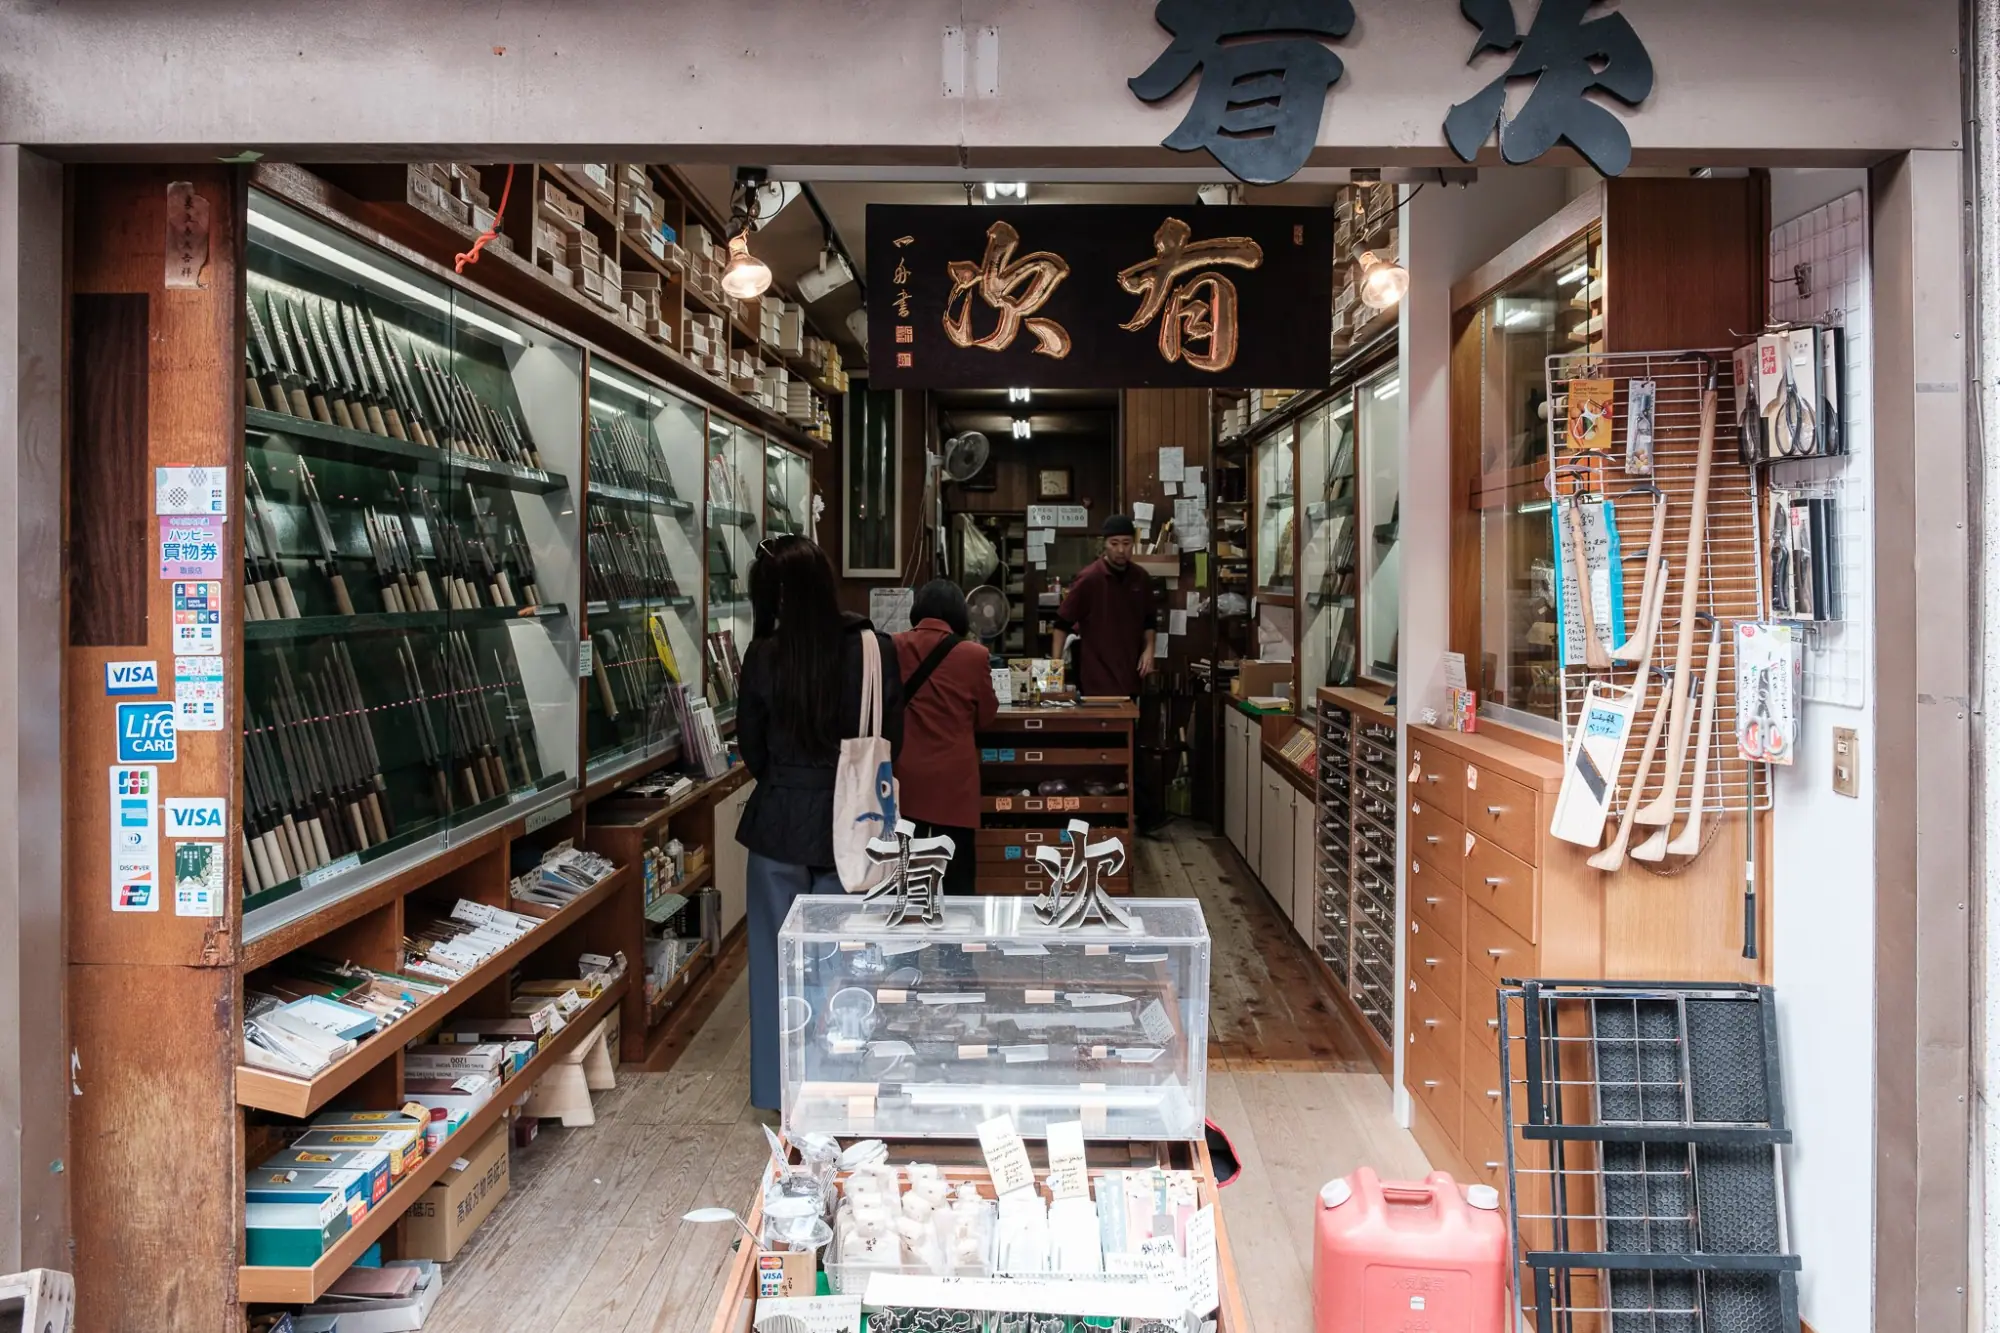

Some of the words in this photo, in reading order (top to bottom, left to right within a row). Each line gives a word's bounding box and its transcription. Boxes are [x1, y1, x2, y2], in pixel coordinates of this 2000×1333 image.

[169, 530, 213, 541] ハッピー
[163, 543, 217, 561] 買物券
[113, 667, 154, 682] VISA
[126, 711, 174, 738] Life
[132, 740, 175, 757] CARD
[170, 808, 222, 826] VISA
[863, 819, 1131, 930] 有次
[763, 1272, 782, 1280] VISA
